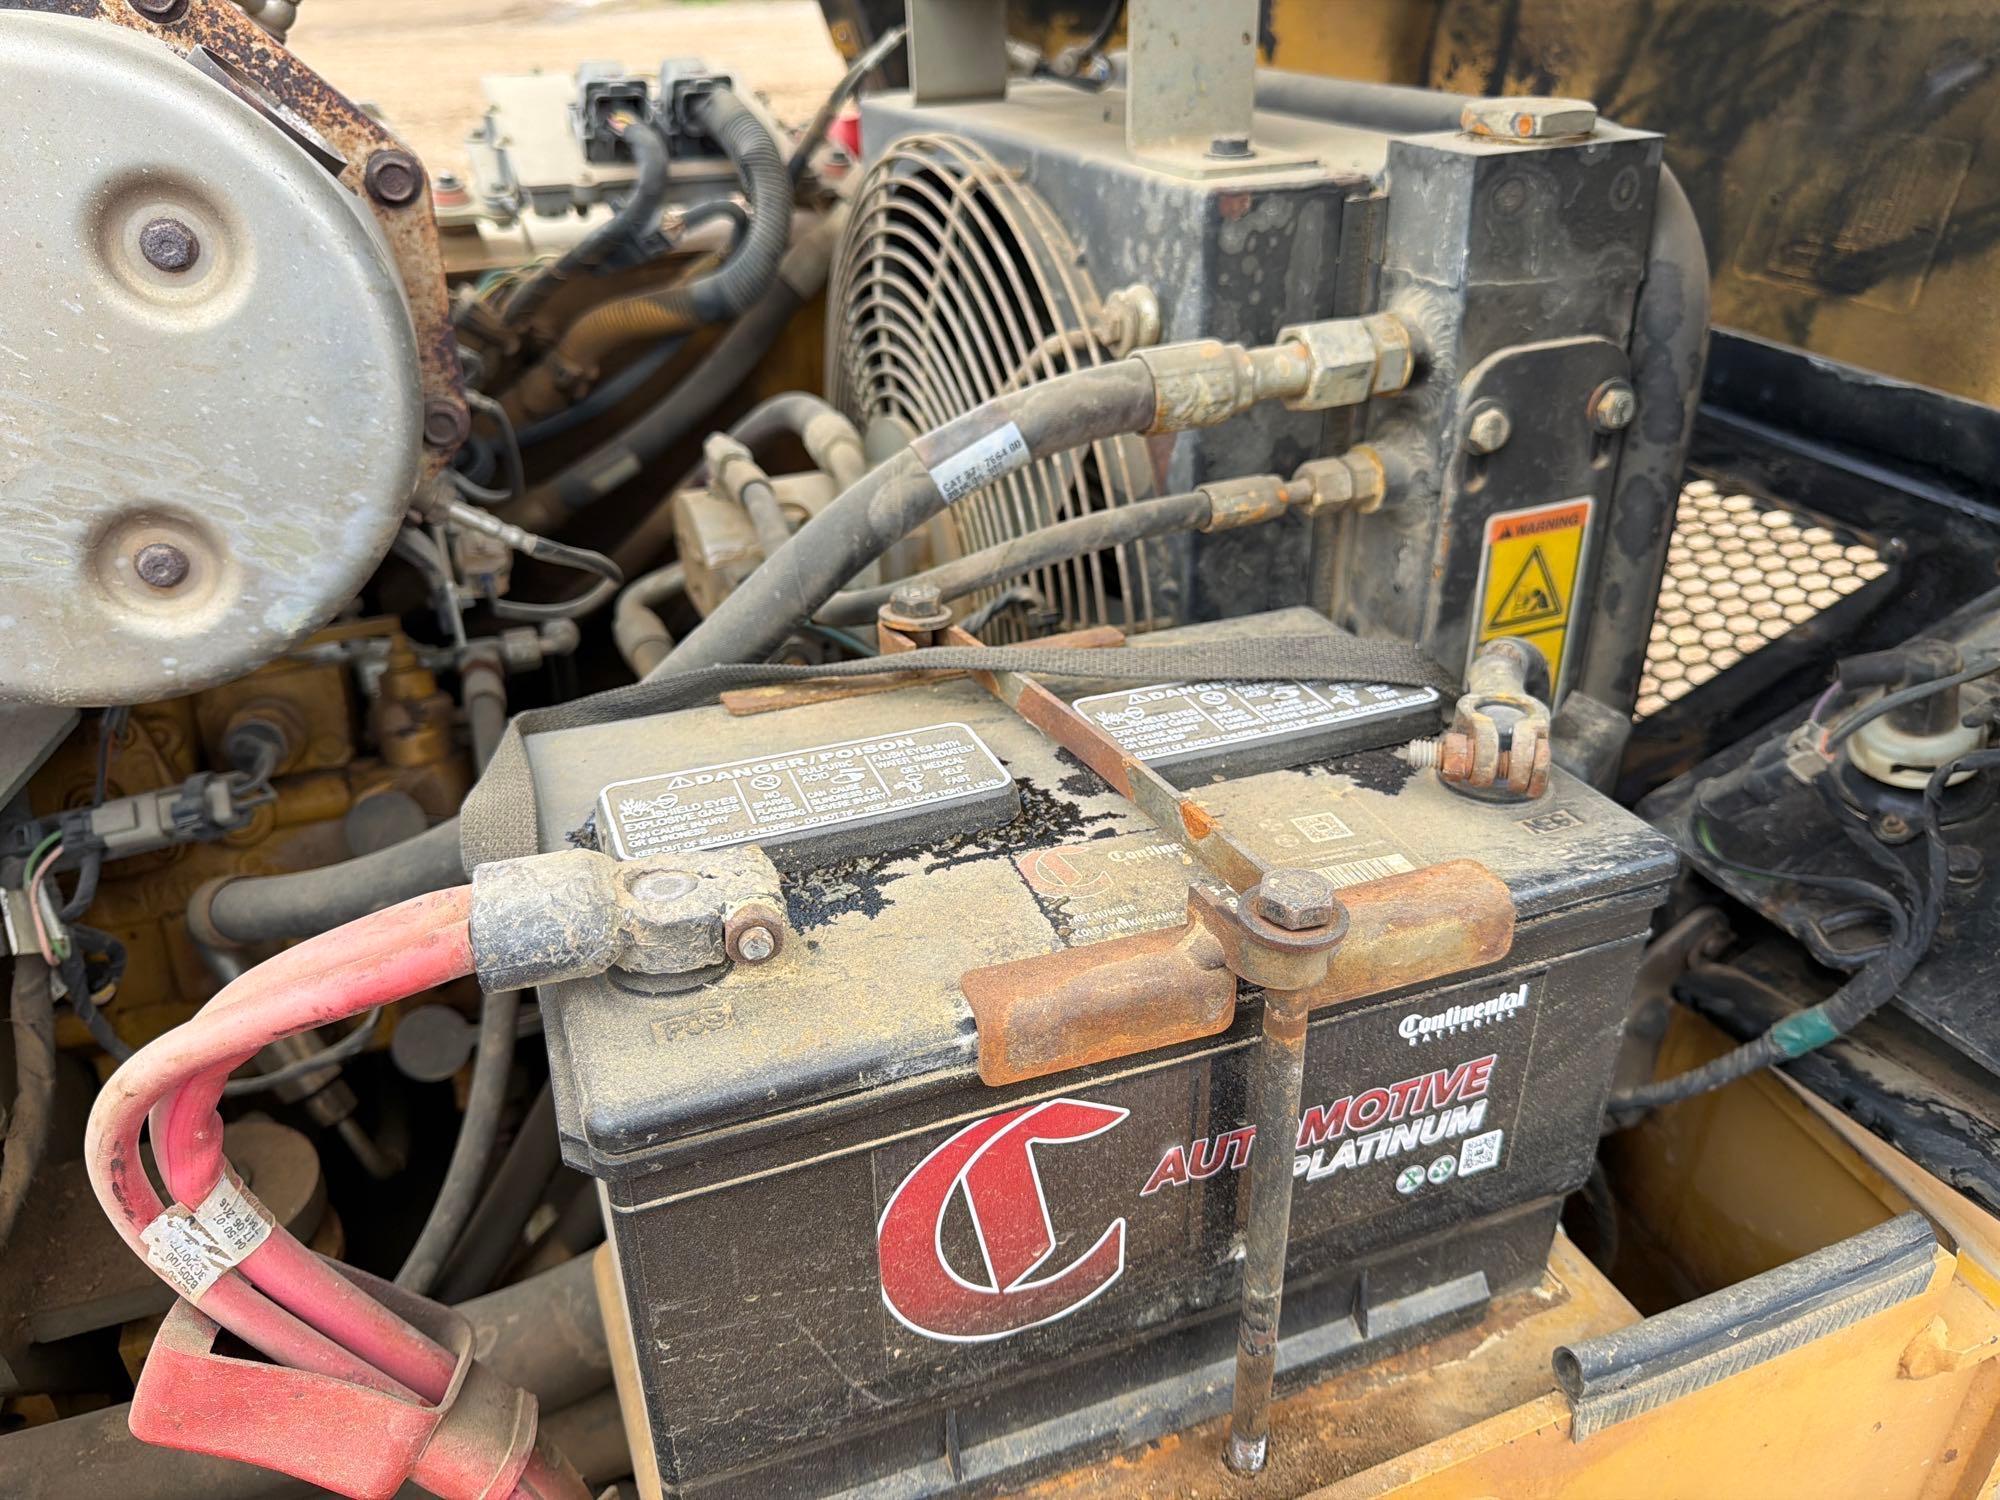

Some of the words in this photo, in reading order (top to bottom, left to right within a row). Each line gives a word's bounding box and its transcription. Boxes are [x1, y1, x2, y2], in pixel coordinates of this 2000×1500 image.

[1518, 514, 1580, 534] WARNING
[1169, 708, 1199, 719] EYES
[871, 750, 906, 763] FLUSH
[907, 744, 934, 757] EYES
[935, 739, 961, 751] WITH
[875, 757, 910, 769] WATER
[913, 744, 977, 763] IMMEDIATELY
[695, 737, 916, 785] DANGER/POISON
[797, 760, 855, 776] SULFURIC
[900, 764, 921, 774] GET
[923, 756, 967, 771] MEDICAL
[802, 771, 830, 784] ACID
[939, 765, 966, 778] HELP
[944, 774, 972, 786] FAST
[762, 790, 782, 800] NO
[806, 790, 828, 799] CAN
[829, 783, 862, 795] CAUSE
[810, 790, 864, 805] BLINDNESS
[865, 786, 882, 795] OR
[654, 803, 702, 818] SHIELD
[703, 796, 739, 808] EYES
[751, 797, 792, 810] SPARKS
[755, 803, 797, 816] FLAMES
[813, 801, 851, 813] SEVERE
[851, 793, 887, 807] INJURY
[623, 813, 697, 833] EXPLOSIVE
[700, 804, 742, 819] GASES
[635, 847, 661, 858] KEEP
[661, 843, 682, 854] OUT
[683, 839, 698, 850] OF
[699, 833, 734, 846] REACH
[734, 829, 747, 840] OF
[747, 821, 796, 837] CHILDREN
[804, 816, 820, 826] DO
[819, 811, 842, 824] NOT
[841, 809, 856, 820] TIP
[864, 802, 890, 814] KEEP
[889, 798, 914, 809] VENT
[914, 793, 938, 803] CAPS
[938, 787, 963, 798] TIGHT
[973, 778, 1000, 790] LEVEL
[758, 809, 808, 823] SMOKING
[625, 831, 651, 842] CAN
[652, 825, 689, 837] CAUSE
[690, 815, 730, 830] INJURY
[629, 838, 648, 849] OR
[649, 828, 709, 845] BLINDNESS
[1093, 903, 1139, 921] NUMBER
[1074, 925, 1101, 939] COLD
[1398, 982, 1531, 1040] Continental
[1408, 1007, 1518, 1048] BATTERIES
[1138, 1052, 1499, 1198] AUTMOTIVE
[213, 1213, 247, 1250] 04:50:07
